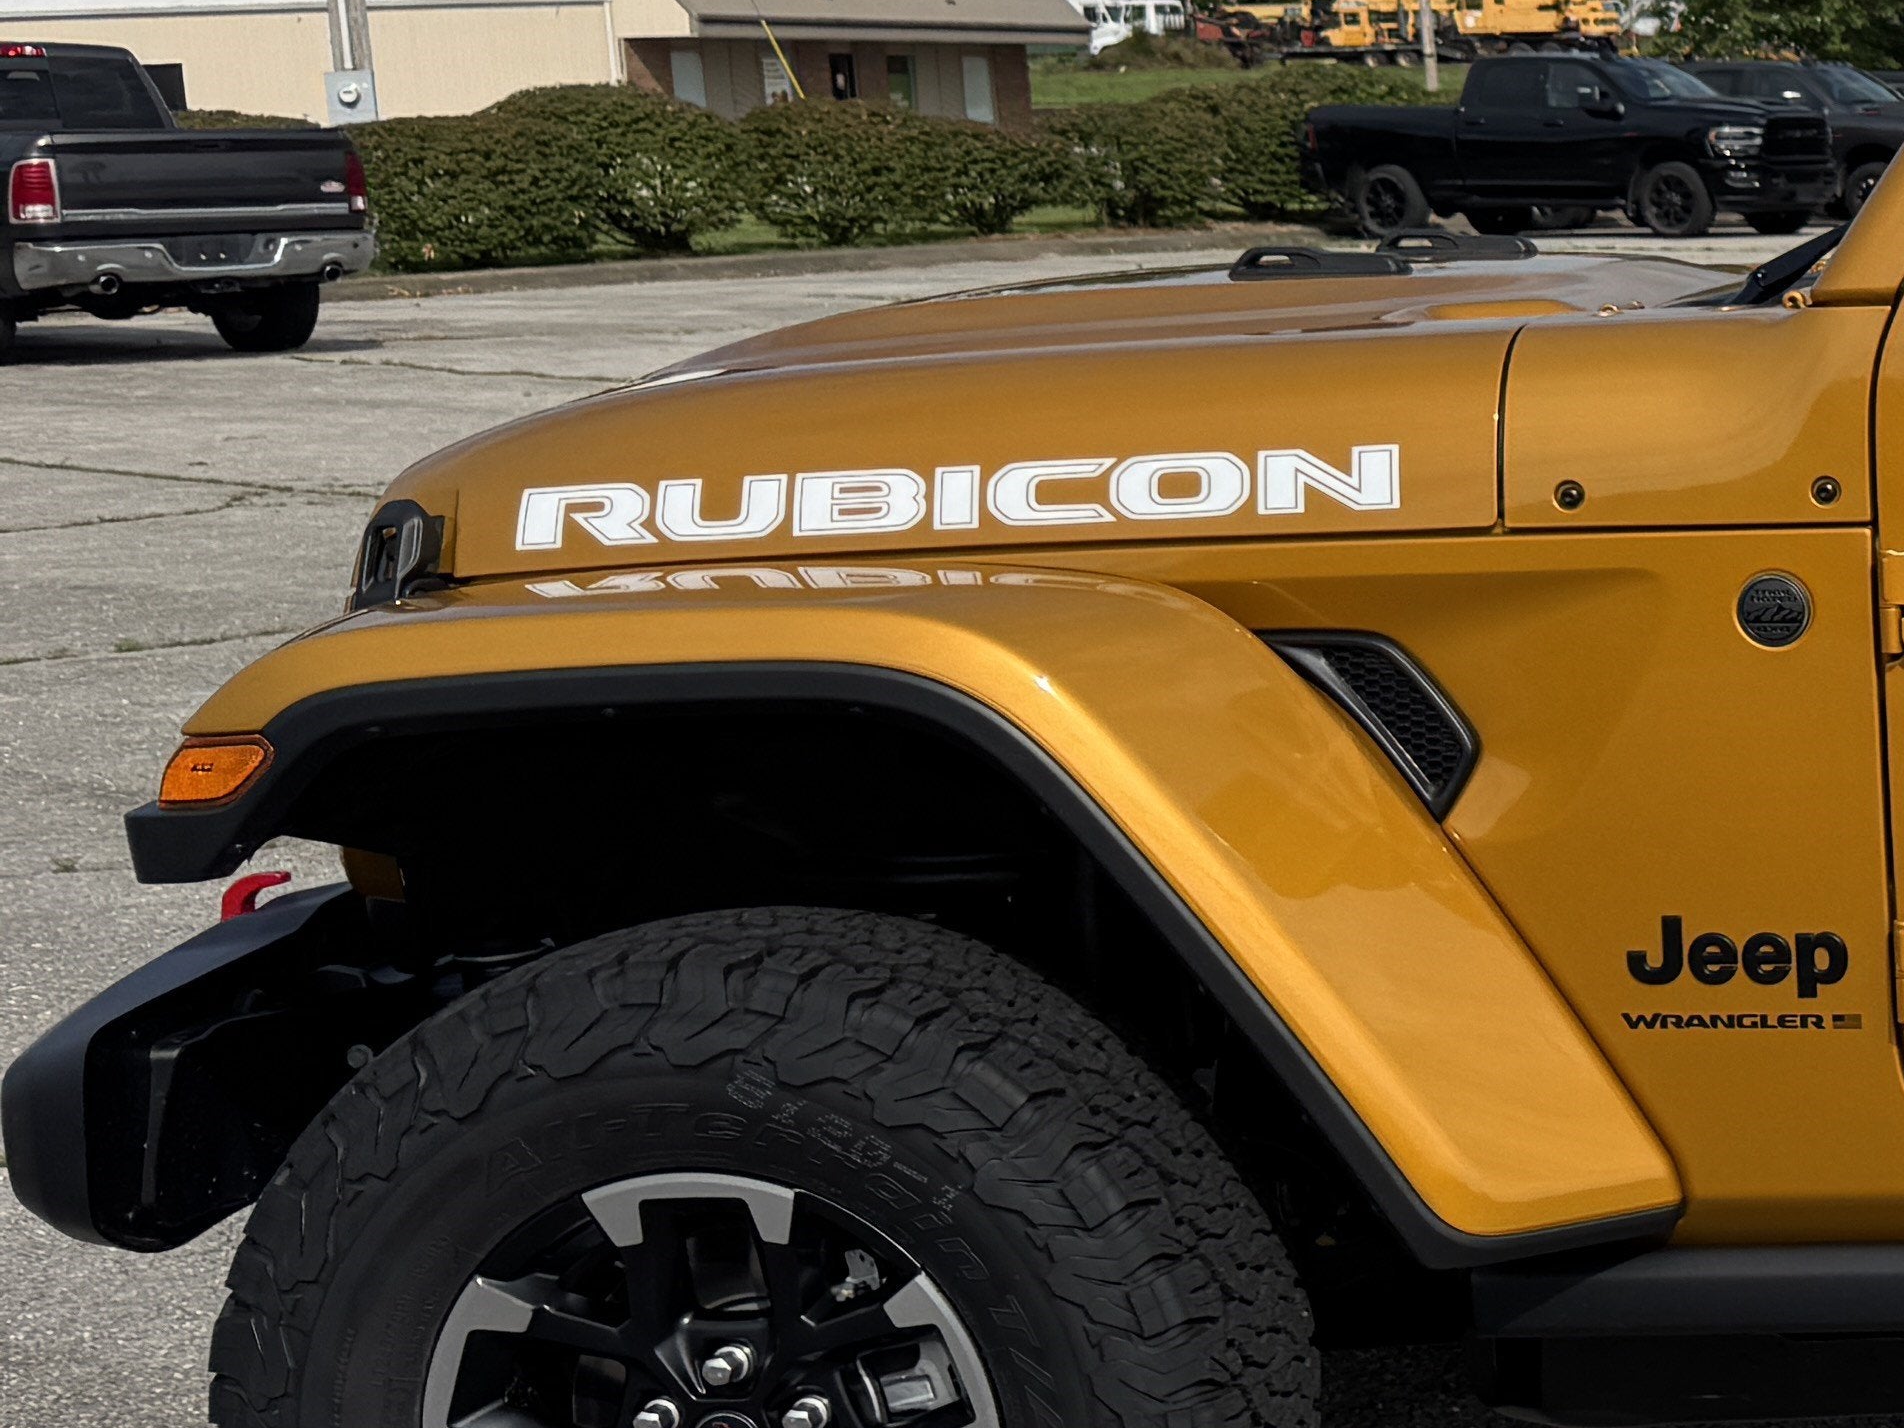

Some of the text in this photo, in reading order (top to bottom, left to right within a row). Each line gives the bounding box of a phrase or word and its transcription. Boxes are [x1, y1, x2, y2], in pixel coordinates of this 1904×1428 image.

[515, 443, 1400, 551] RUBICON
[1626, 915, 1849, 999] Jeep
[1620, 1012, 1827, 1030] WRANGLER
